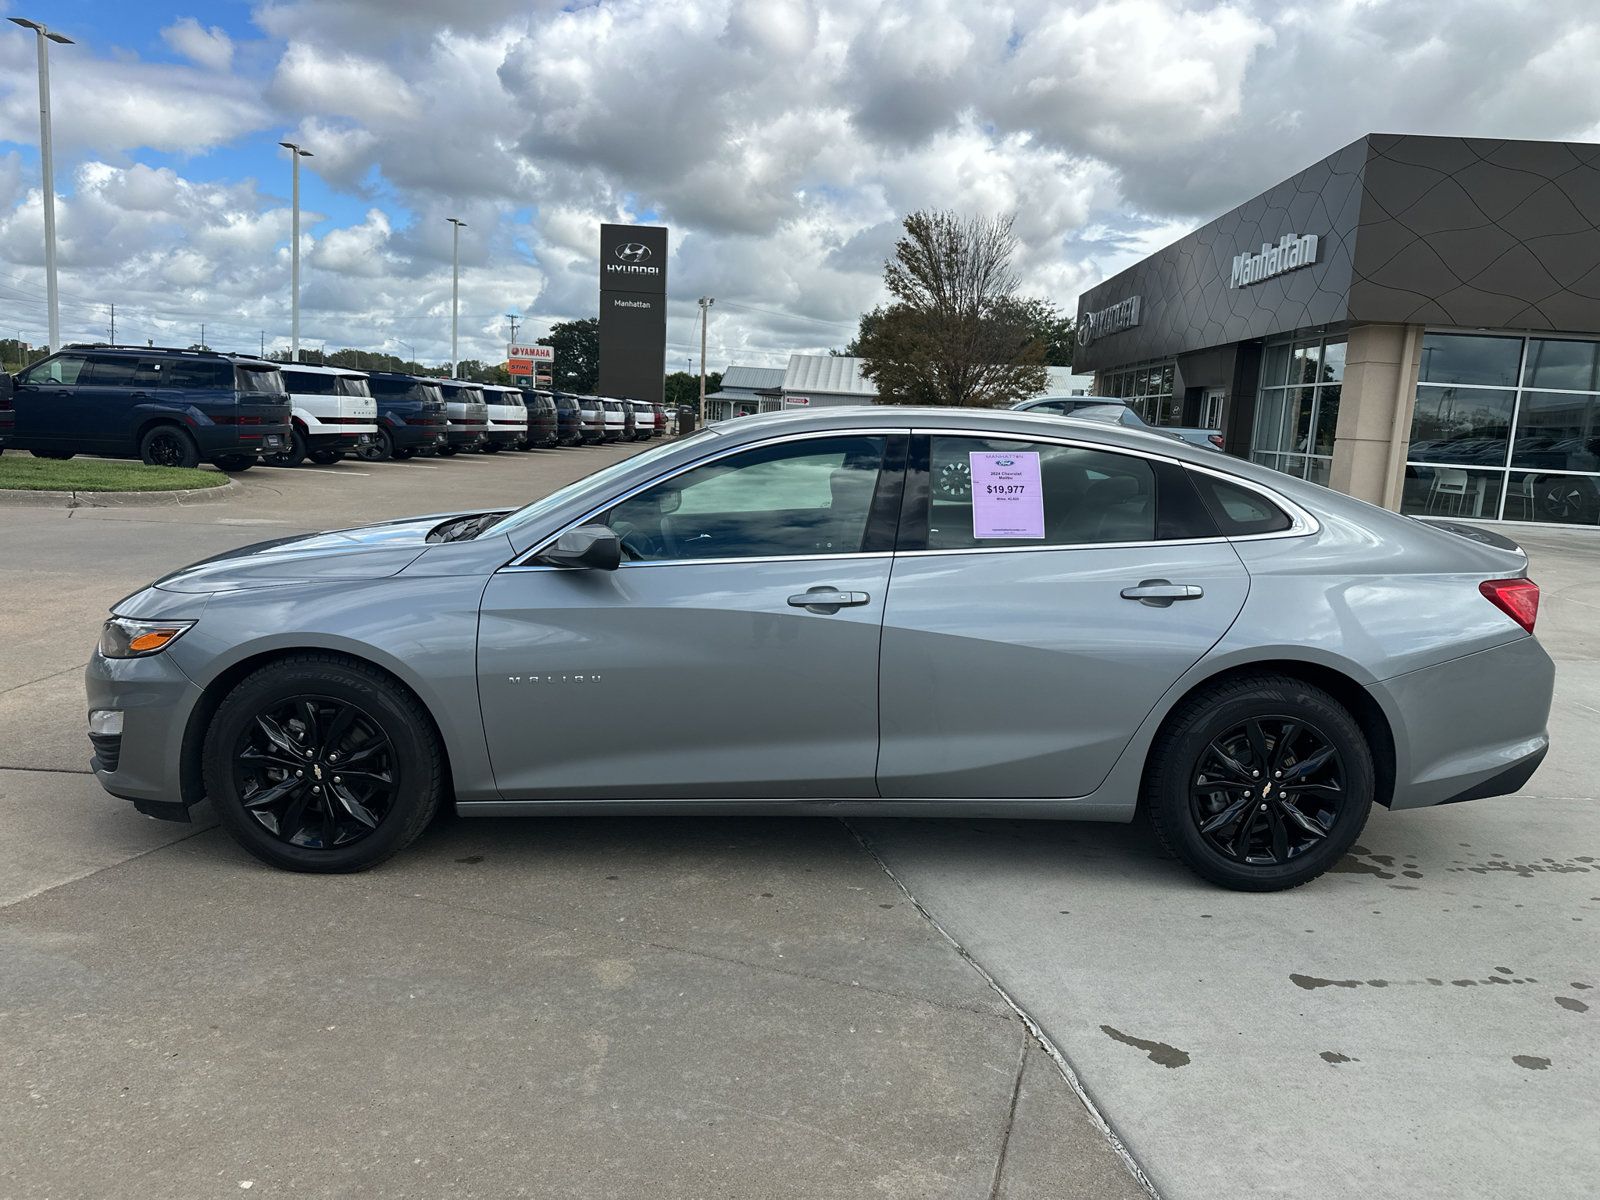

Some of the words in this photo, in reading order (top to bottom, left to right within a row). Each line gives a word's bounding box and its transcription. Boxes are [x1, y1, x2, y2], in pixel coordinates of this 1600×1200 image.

[1230, 233, 1318, 289] Manhattan
[606, 264, 659, 275] HYUNDAI
[614, 299, 651, 308] Manhattan
[520, 347, 551, 357] YAMAHA
[986, 485, 1025, 495] $19,977
[508, 675, 601, 684] MALIBU
